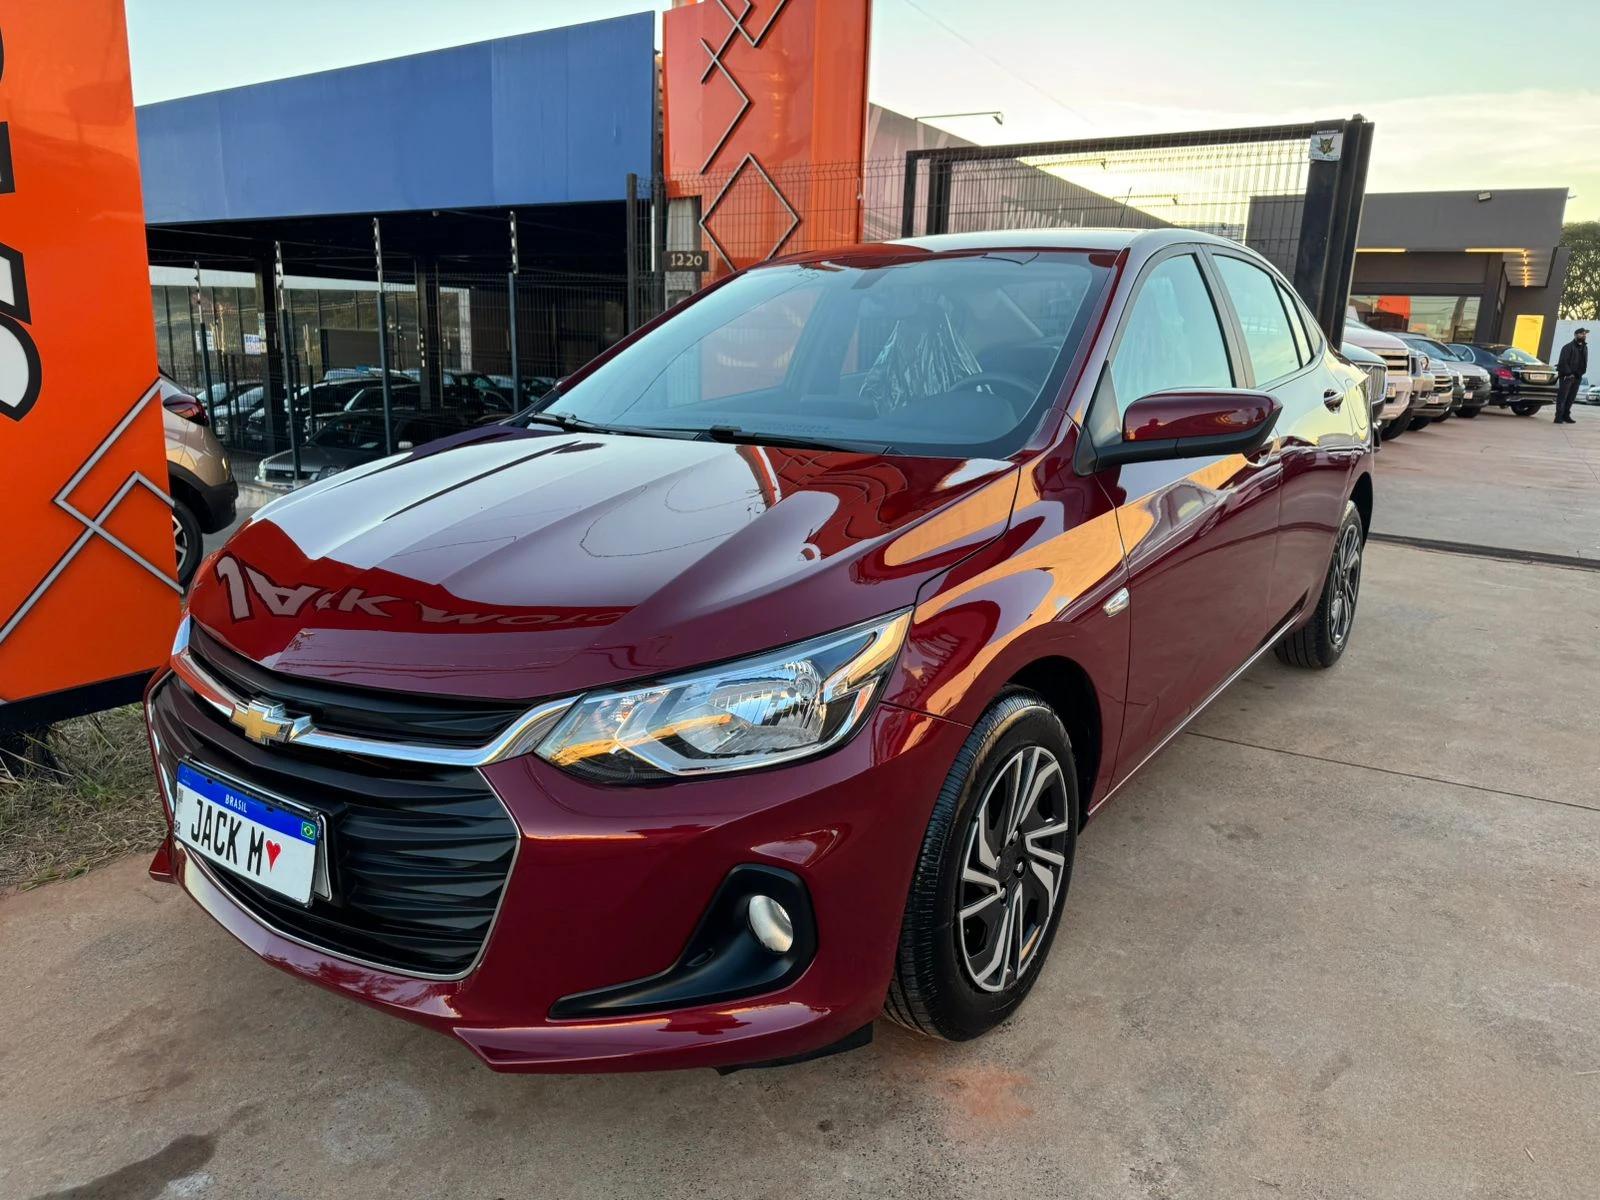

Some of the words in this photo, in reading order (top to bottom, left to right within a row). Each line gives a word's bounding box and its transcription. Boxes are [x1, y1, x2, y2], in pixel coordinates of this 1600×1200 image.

[671, 253, 703, 267] 1220
[225, 794, 248, 814] BRASIL
[190, 798, 242, 866] JACK
[246, 826, 265, 877] M
